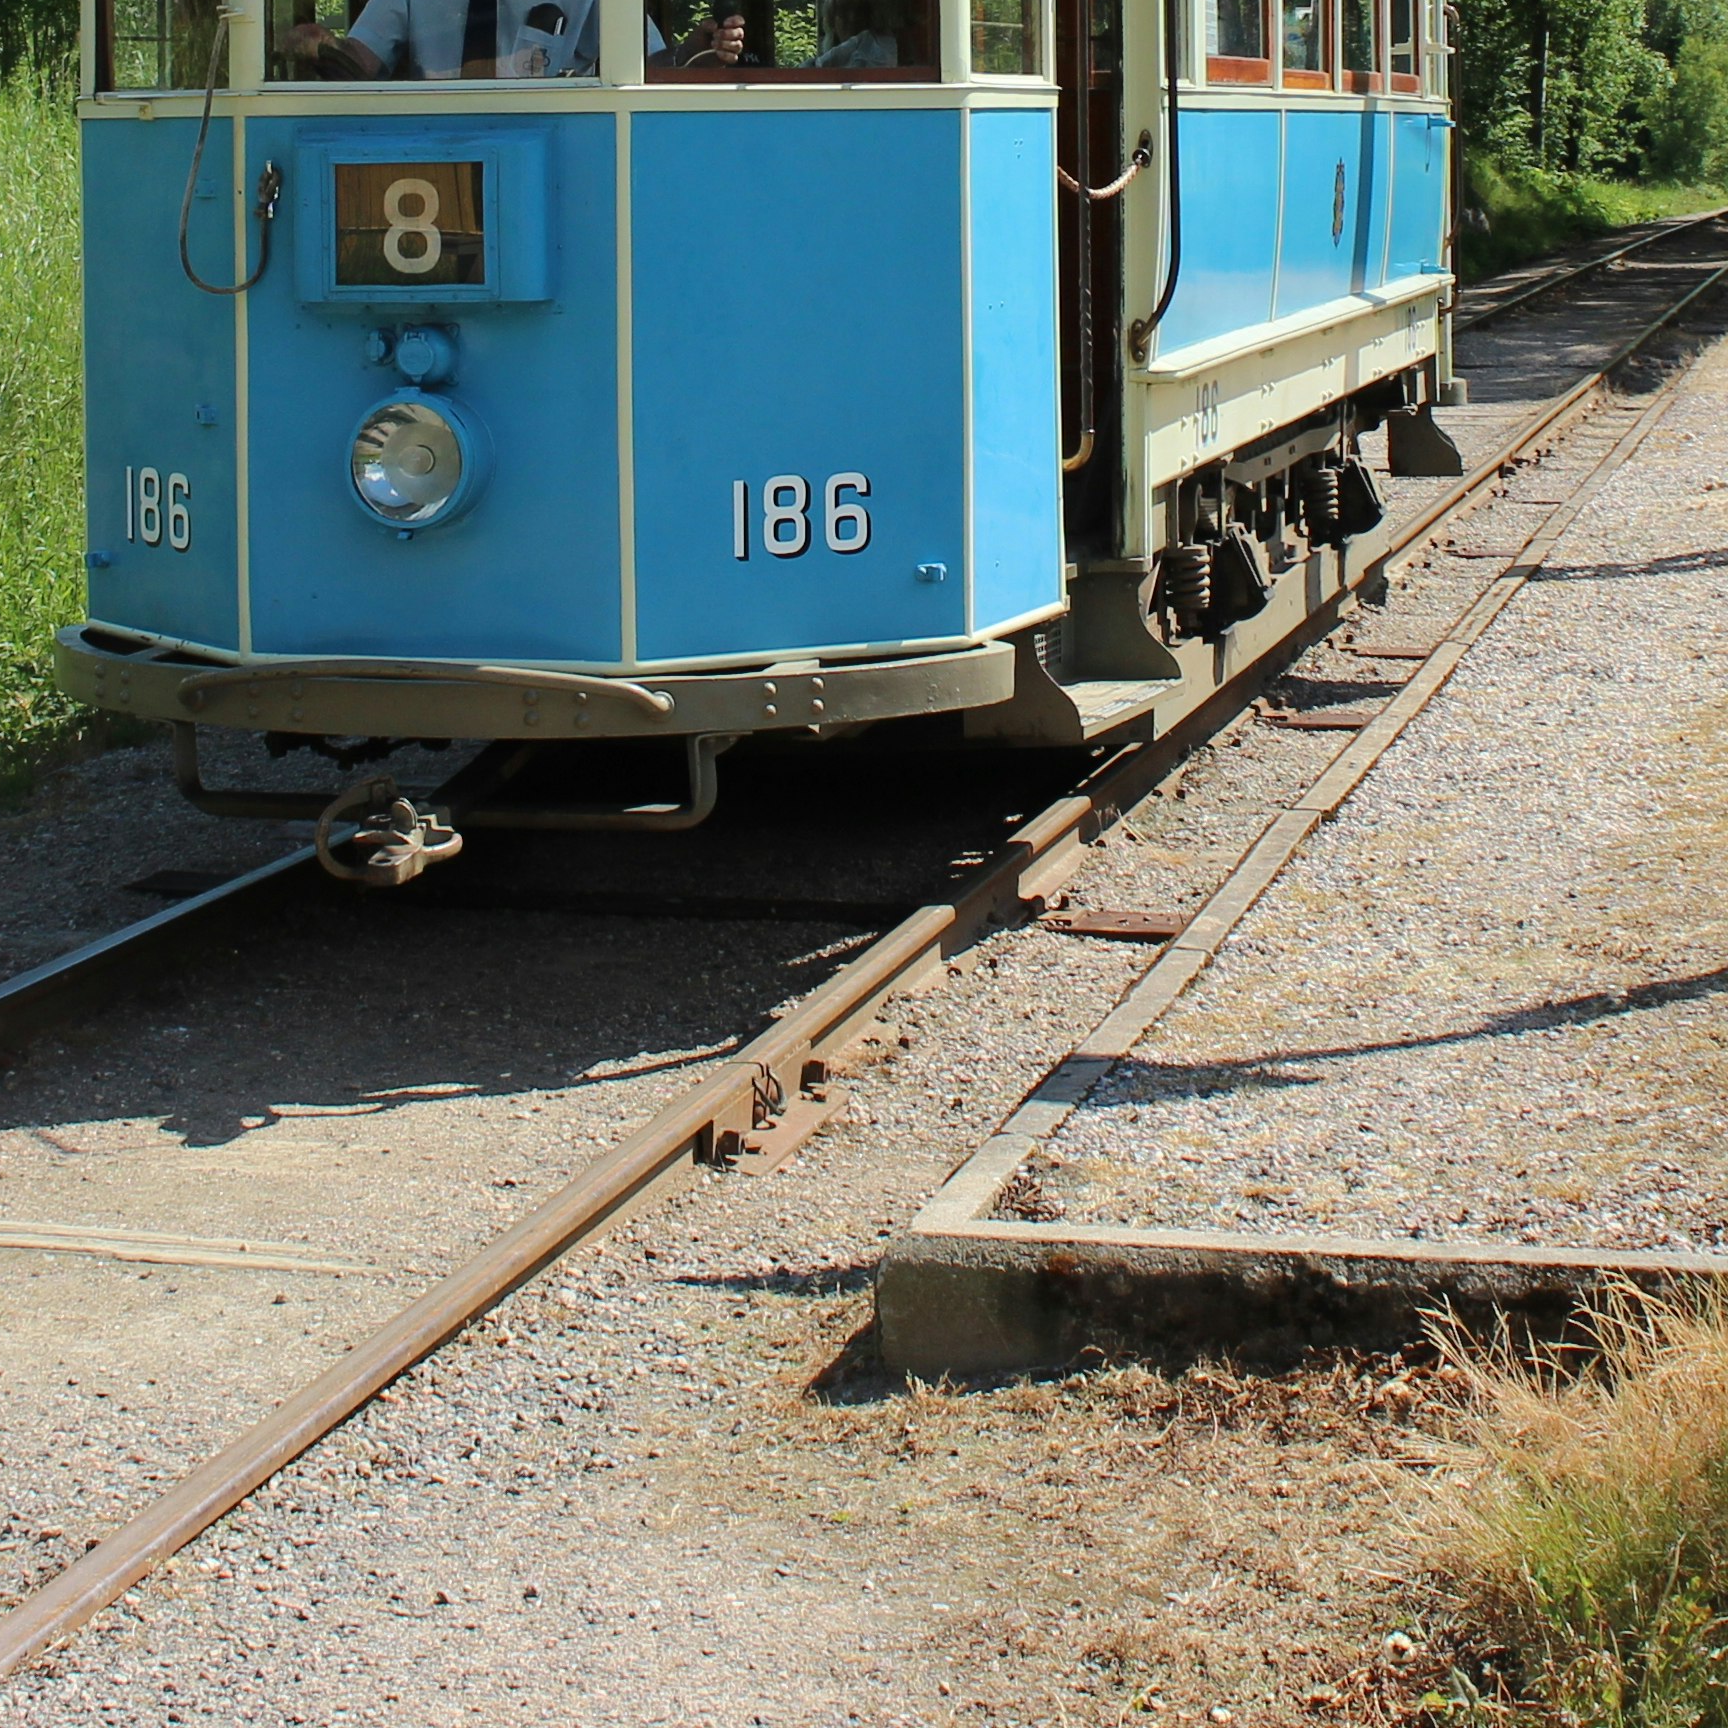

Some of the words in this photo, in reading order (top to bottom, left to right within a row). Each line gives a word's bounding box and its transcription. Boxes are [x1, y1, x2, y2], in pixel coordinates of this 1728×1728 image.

[382, 178, 441, 274] 8
[1195, 379, 1218, 449] 186
[125, 465, 192, 551] 186
[732, 472, 872, 561] 186
